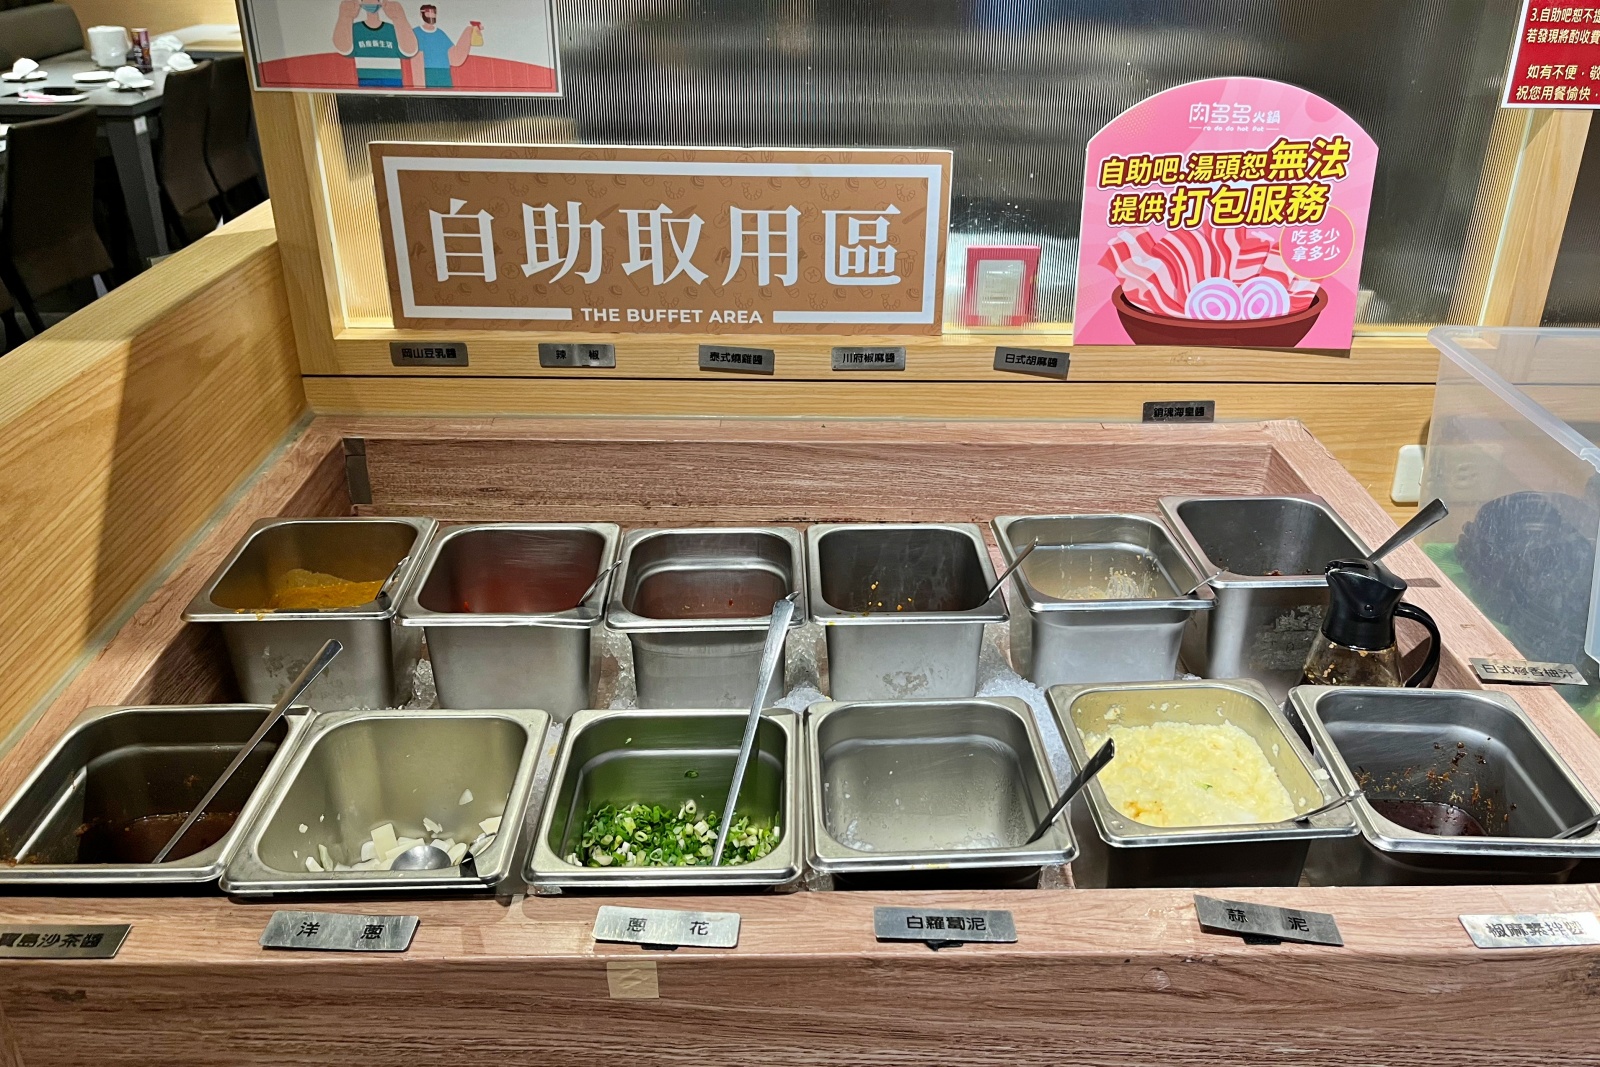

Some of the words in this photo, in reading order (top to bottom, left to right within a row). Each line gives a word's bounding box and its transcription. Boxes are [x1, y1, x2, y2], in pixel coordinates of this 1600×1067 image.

[1189, 102, 1280, 124] 肉多多火鍋
[1110, 182, 1330, 228] 提供打包服務
[429, 198, 902, 287] 自助取用區
[1291, 228, 1341, 245] 吃多少
[1291, 244, 1341, 263] 拿多少
[581, 307, 620, 323] THE
[627, 308, 703, 324] BUFFET
[708, 309, 764, 325] AREA
[401, 347, 457, 359] 岡山豆乳醬
[556, 349, 600, 360] 辣椒
[842, 352, 895, 363] 川府椒麻醬
[1005, 353, 1058, 368] 日式胡麻醬
[906, 915, 987, 931] 白蘿蔔泥
[1227, 908, 1310, 932] 蒜泥
